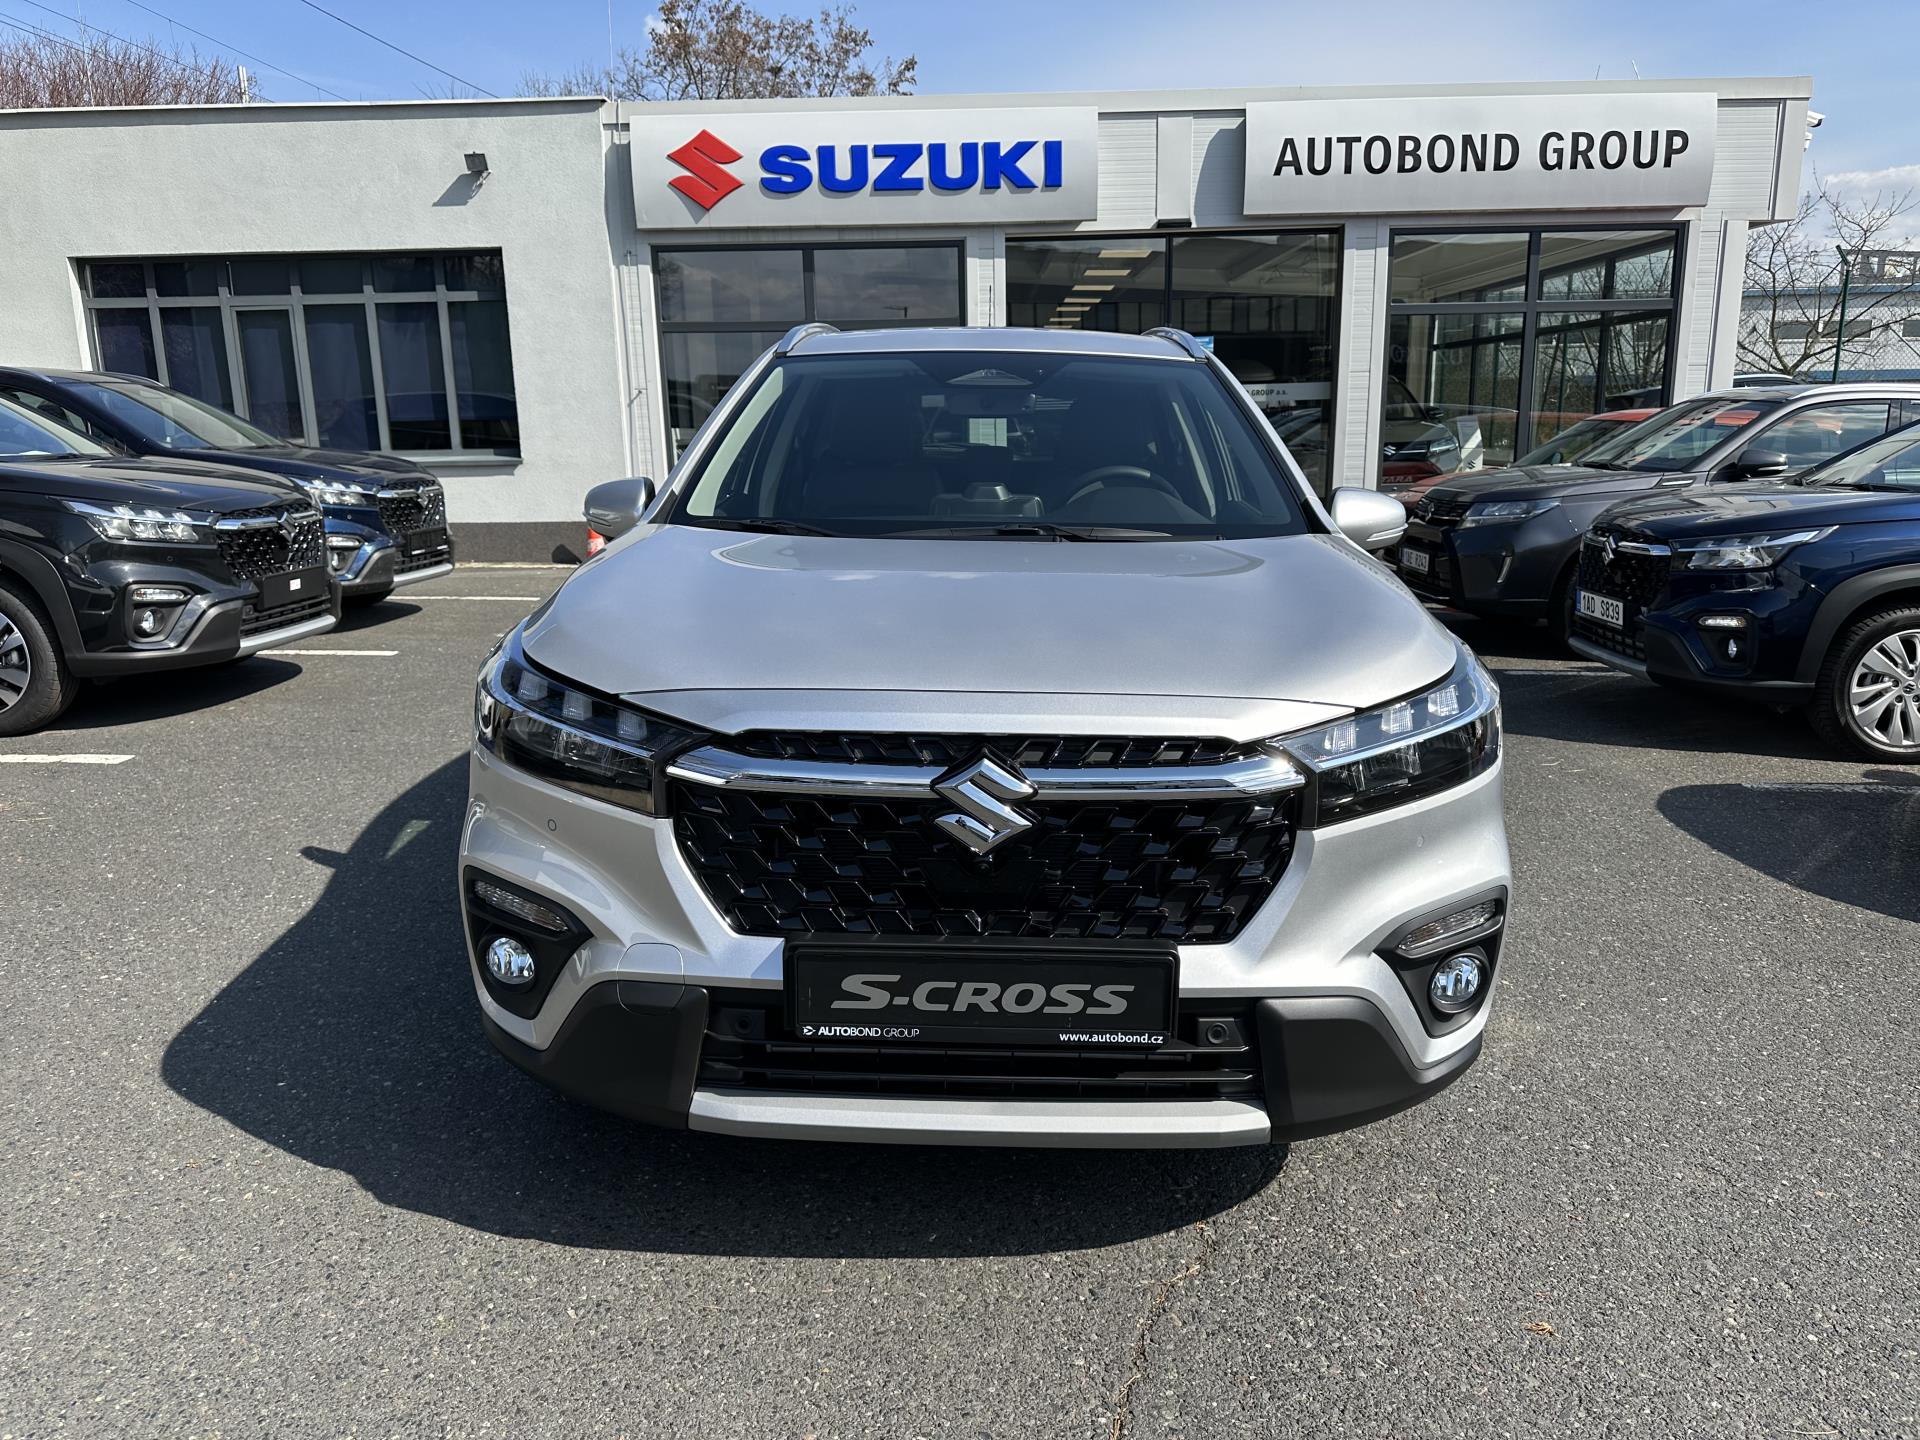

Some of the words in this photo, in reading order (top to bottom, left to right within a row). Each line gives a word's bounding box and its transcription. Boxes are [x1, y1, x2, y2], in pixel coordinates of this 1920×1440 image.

[760, 140, 1063, 193] SUZUKI
[1273, 133, 1520, 176] AUTOBOND
[1539, 130, 1689, 171] GROUP
[1582, 594, 1596, 614] 1AD
[1600, 600, 1620, 622] S839
[830, 973, 1135, 1015] S-CROSS
[818, 1026, 882, 1037] AUTOBOND
[883, 1028, 920, 1038] GROUP
[1059, 1033, 1164, 1044] www.autobond.cz
